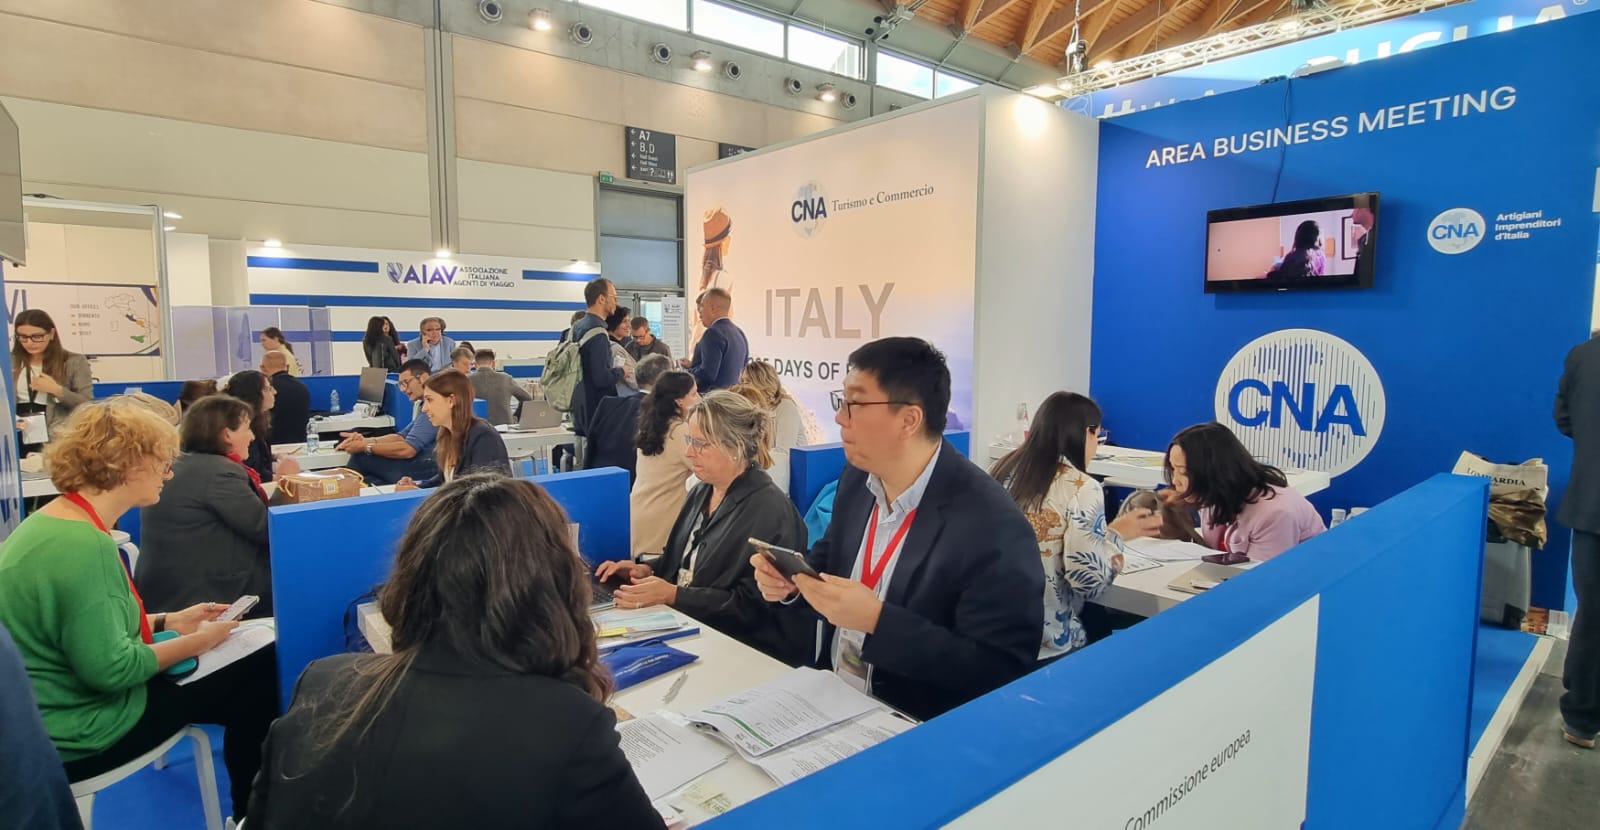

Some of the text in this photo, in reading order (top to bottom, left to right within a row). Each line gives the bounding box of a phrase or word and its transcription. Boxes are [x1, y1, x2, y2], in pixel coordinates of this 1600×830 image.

[639, 130, 651, 141] A7
[1145, 85, 1517, 169] AREA BUSINESS MEETING
[791, 183, 935, 223] CNA Turismo e Commercio
[1431, 209, 1543, 240] CNA Artigiani
[1495, 218, 1562, 231] Imprenditori
[1495, 231, 1530, 241] d'Italia
[403, 263, 458, 285] AIAV
[460, 266, 508, 275] ASSOCIAZIONE
[468, 273, 500, 281] ITALIANA
[489, 280, 515, 288] VIAGGIO
[765, 282, 895, 339] ITALY
[774, 358, 813, 379] DAYS
[818, 361, 840, 380] OF
[1228, 378, 1367, 437] CNA
[1124, 729, 1251, 830] Commissione europea
